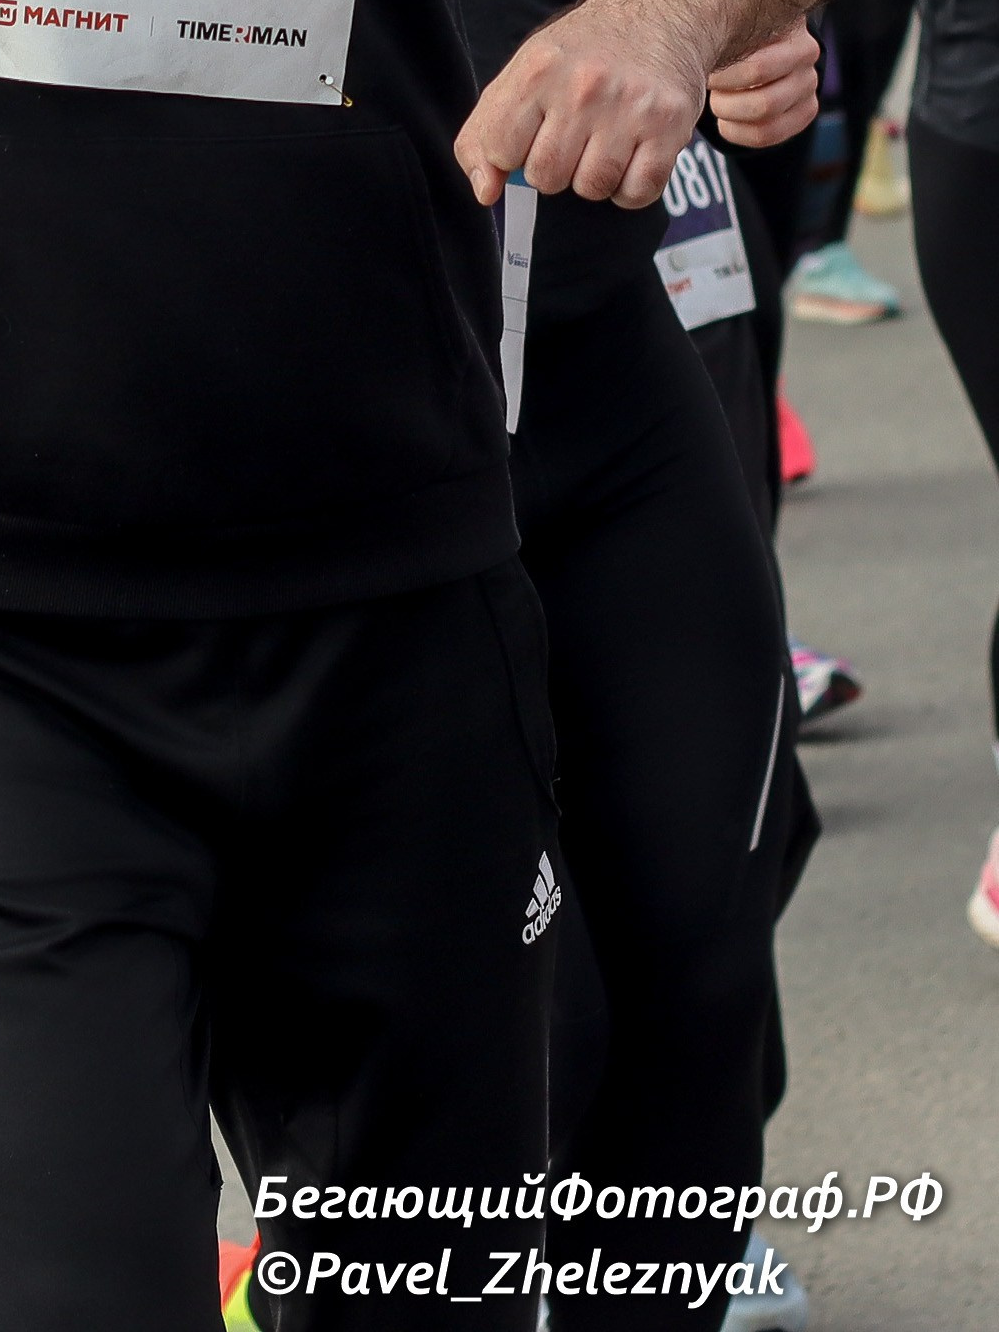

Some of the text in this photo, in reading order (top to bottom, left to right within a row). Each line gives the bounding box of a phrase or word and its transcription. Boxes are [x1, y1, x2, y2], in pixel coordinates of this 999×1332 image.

[23, 5, 129, 33] МАГНИТ
[176, 19, 308, 47] TIMERMAN
[521, 885, 562, 945] adidas
